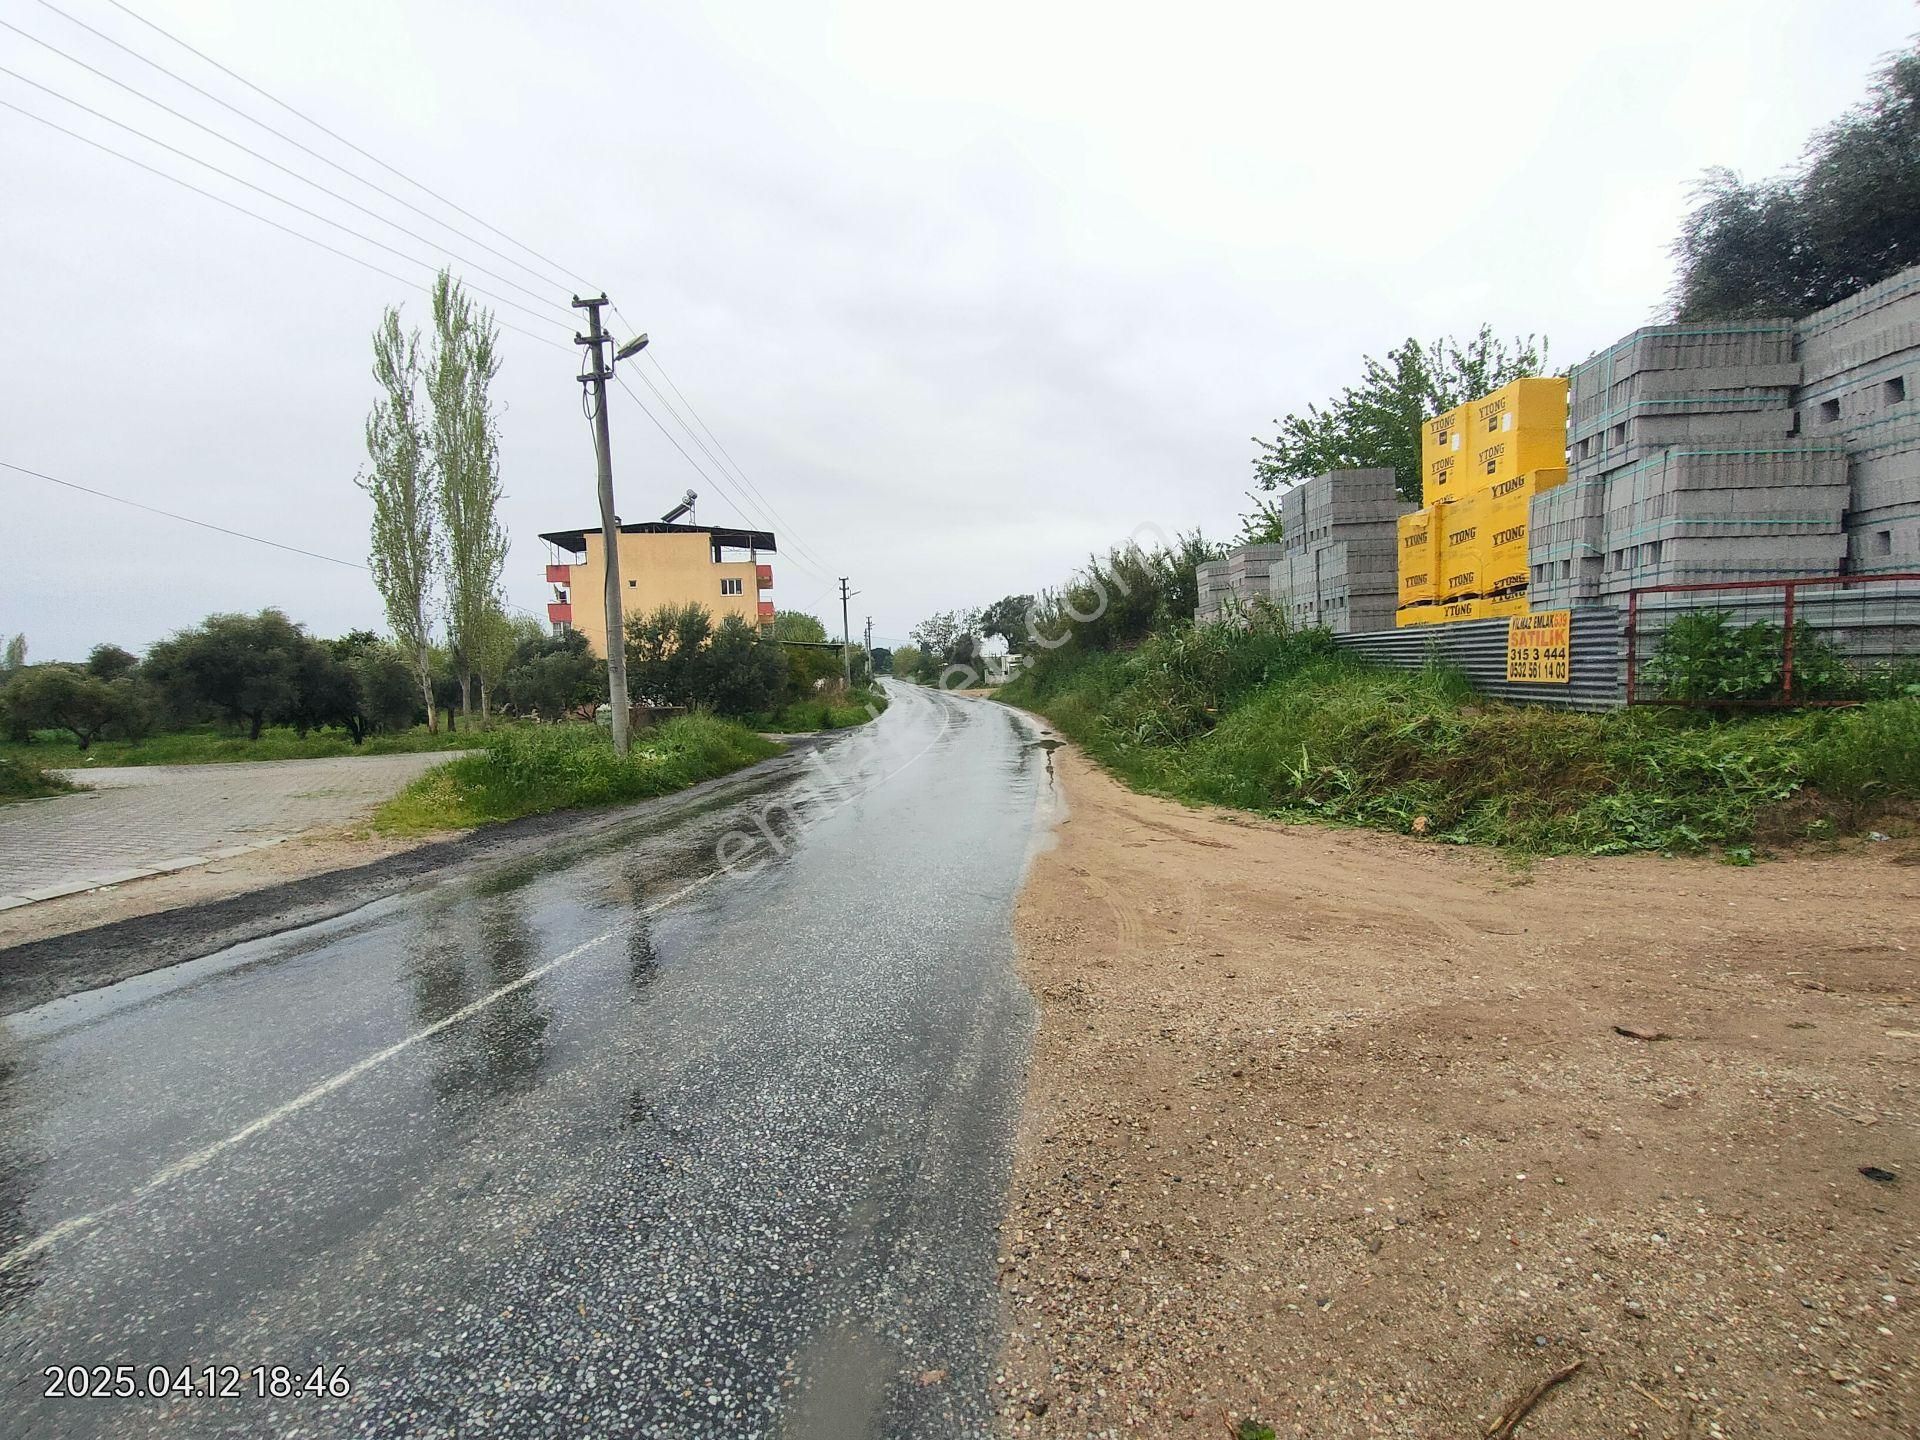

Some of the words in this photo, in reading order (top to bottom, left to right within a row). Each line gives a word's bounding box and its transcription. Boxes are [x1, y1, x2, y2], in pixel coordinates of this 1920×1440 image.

[1479, 397, 1506, 419] YTONG
[1431, 414, 1456, 432] YTONG
[1479, 443, 1505, 463] YTONG
[1431, 456, 1455, 473] YTONG
[1491, 474, 1525, 498] YTONG
[1404, 532, 1428, 547] YTONG
[1449, 527, 1477, 547] YTONG
[1492, 525, 1526, 546] YTONG
[1405, 574, 1428, 588] YTONG
[1449, 572, 1474, 588] YTONG
[1444, 603, 1472, 617] YTONG
[1533, 614, 1554, 629] EMLAK
[1511, 630, 1566, 647] SATILIK
[1510, 648, 1529, 660] 315
[1532, 648, 1540, 661] 3
[1543, 647, 1566, 661] 444
[1510, 662, 1526, 678] 0532
[1528, 662, 1541, 679] 561
[1544, 662, 1554, 679] 14
[1556, 662, 1566, 679] 03
